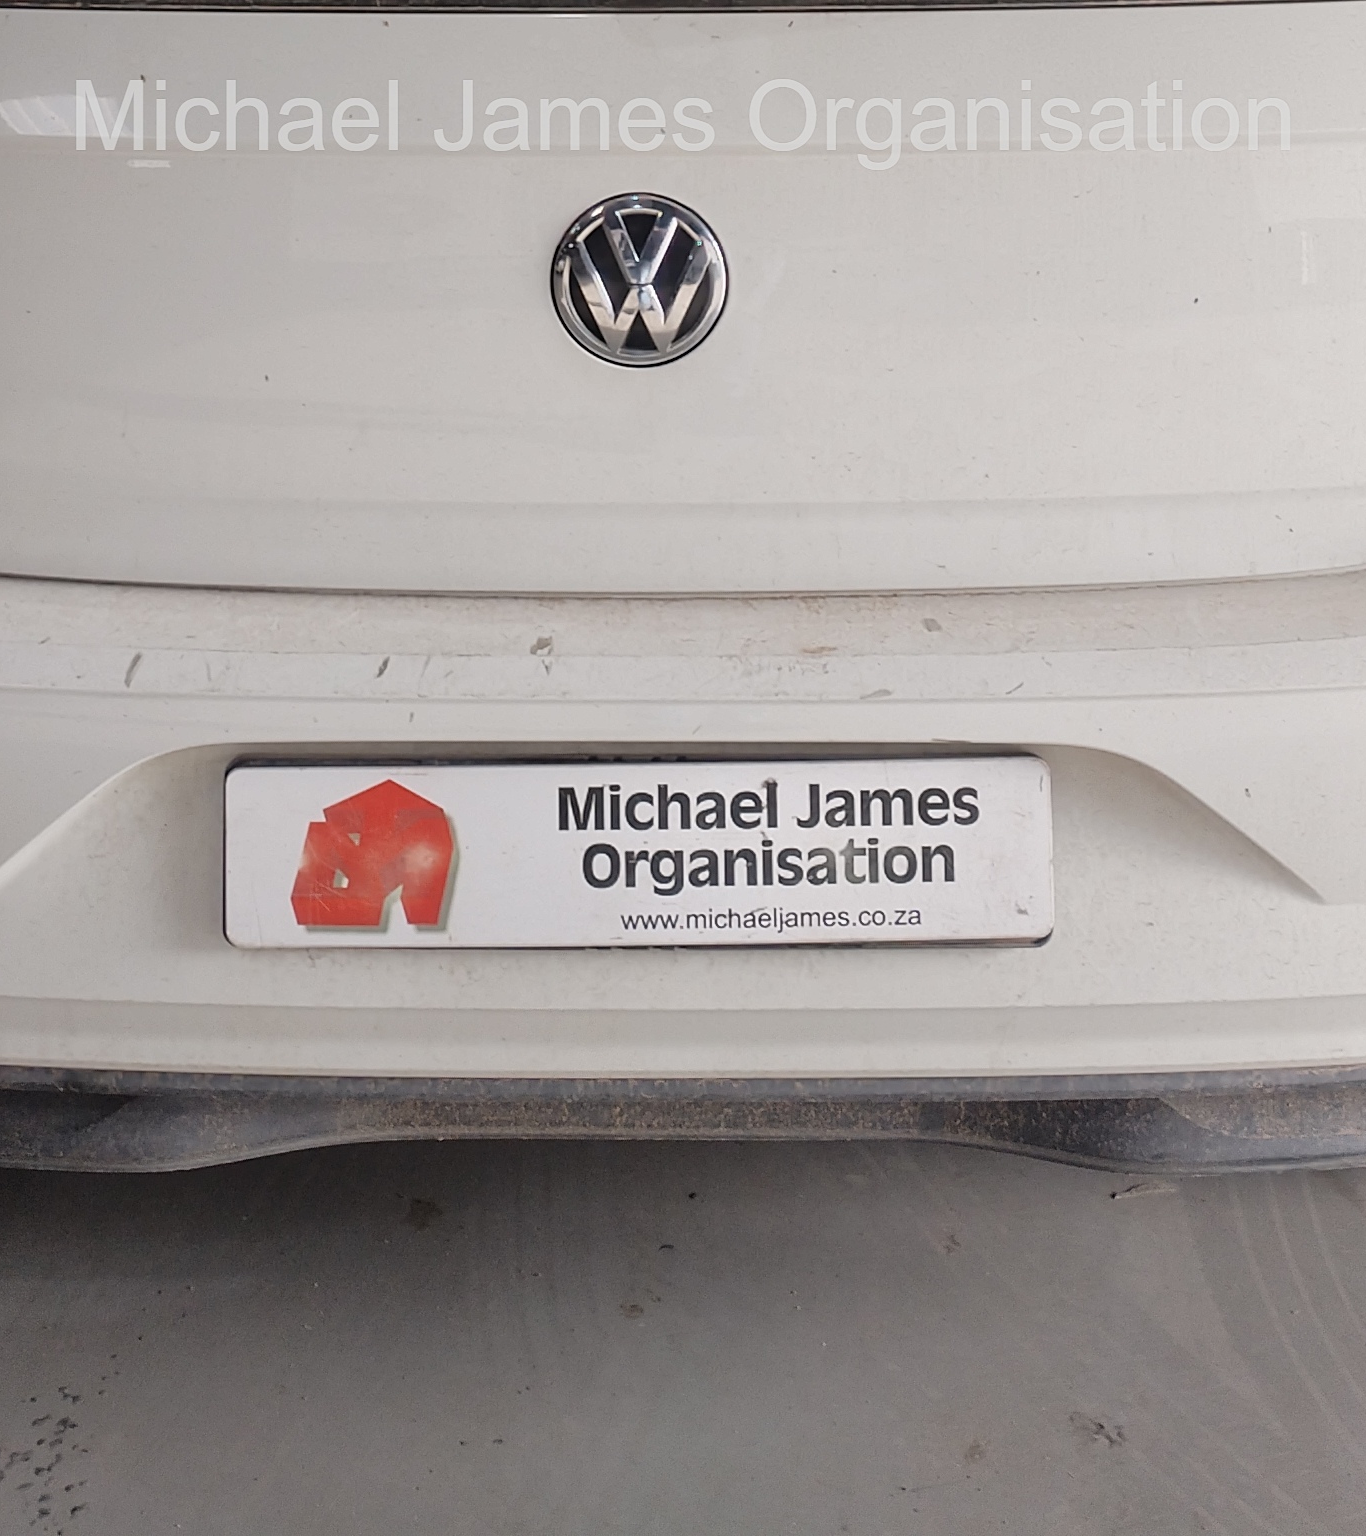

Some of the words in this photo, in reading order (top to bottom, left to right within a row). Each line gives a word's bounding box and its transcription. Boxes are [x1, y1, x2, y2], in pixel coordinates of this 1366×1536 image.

[557, 780, 778, 831] Michael
[796, 783, 980, 829] James
[582, 837, 955, 897] Organisation
[620, 907, 922, 934] www.michaeljames.co.za
